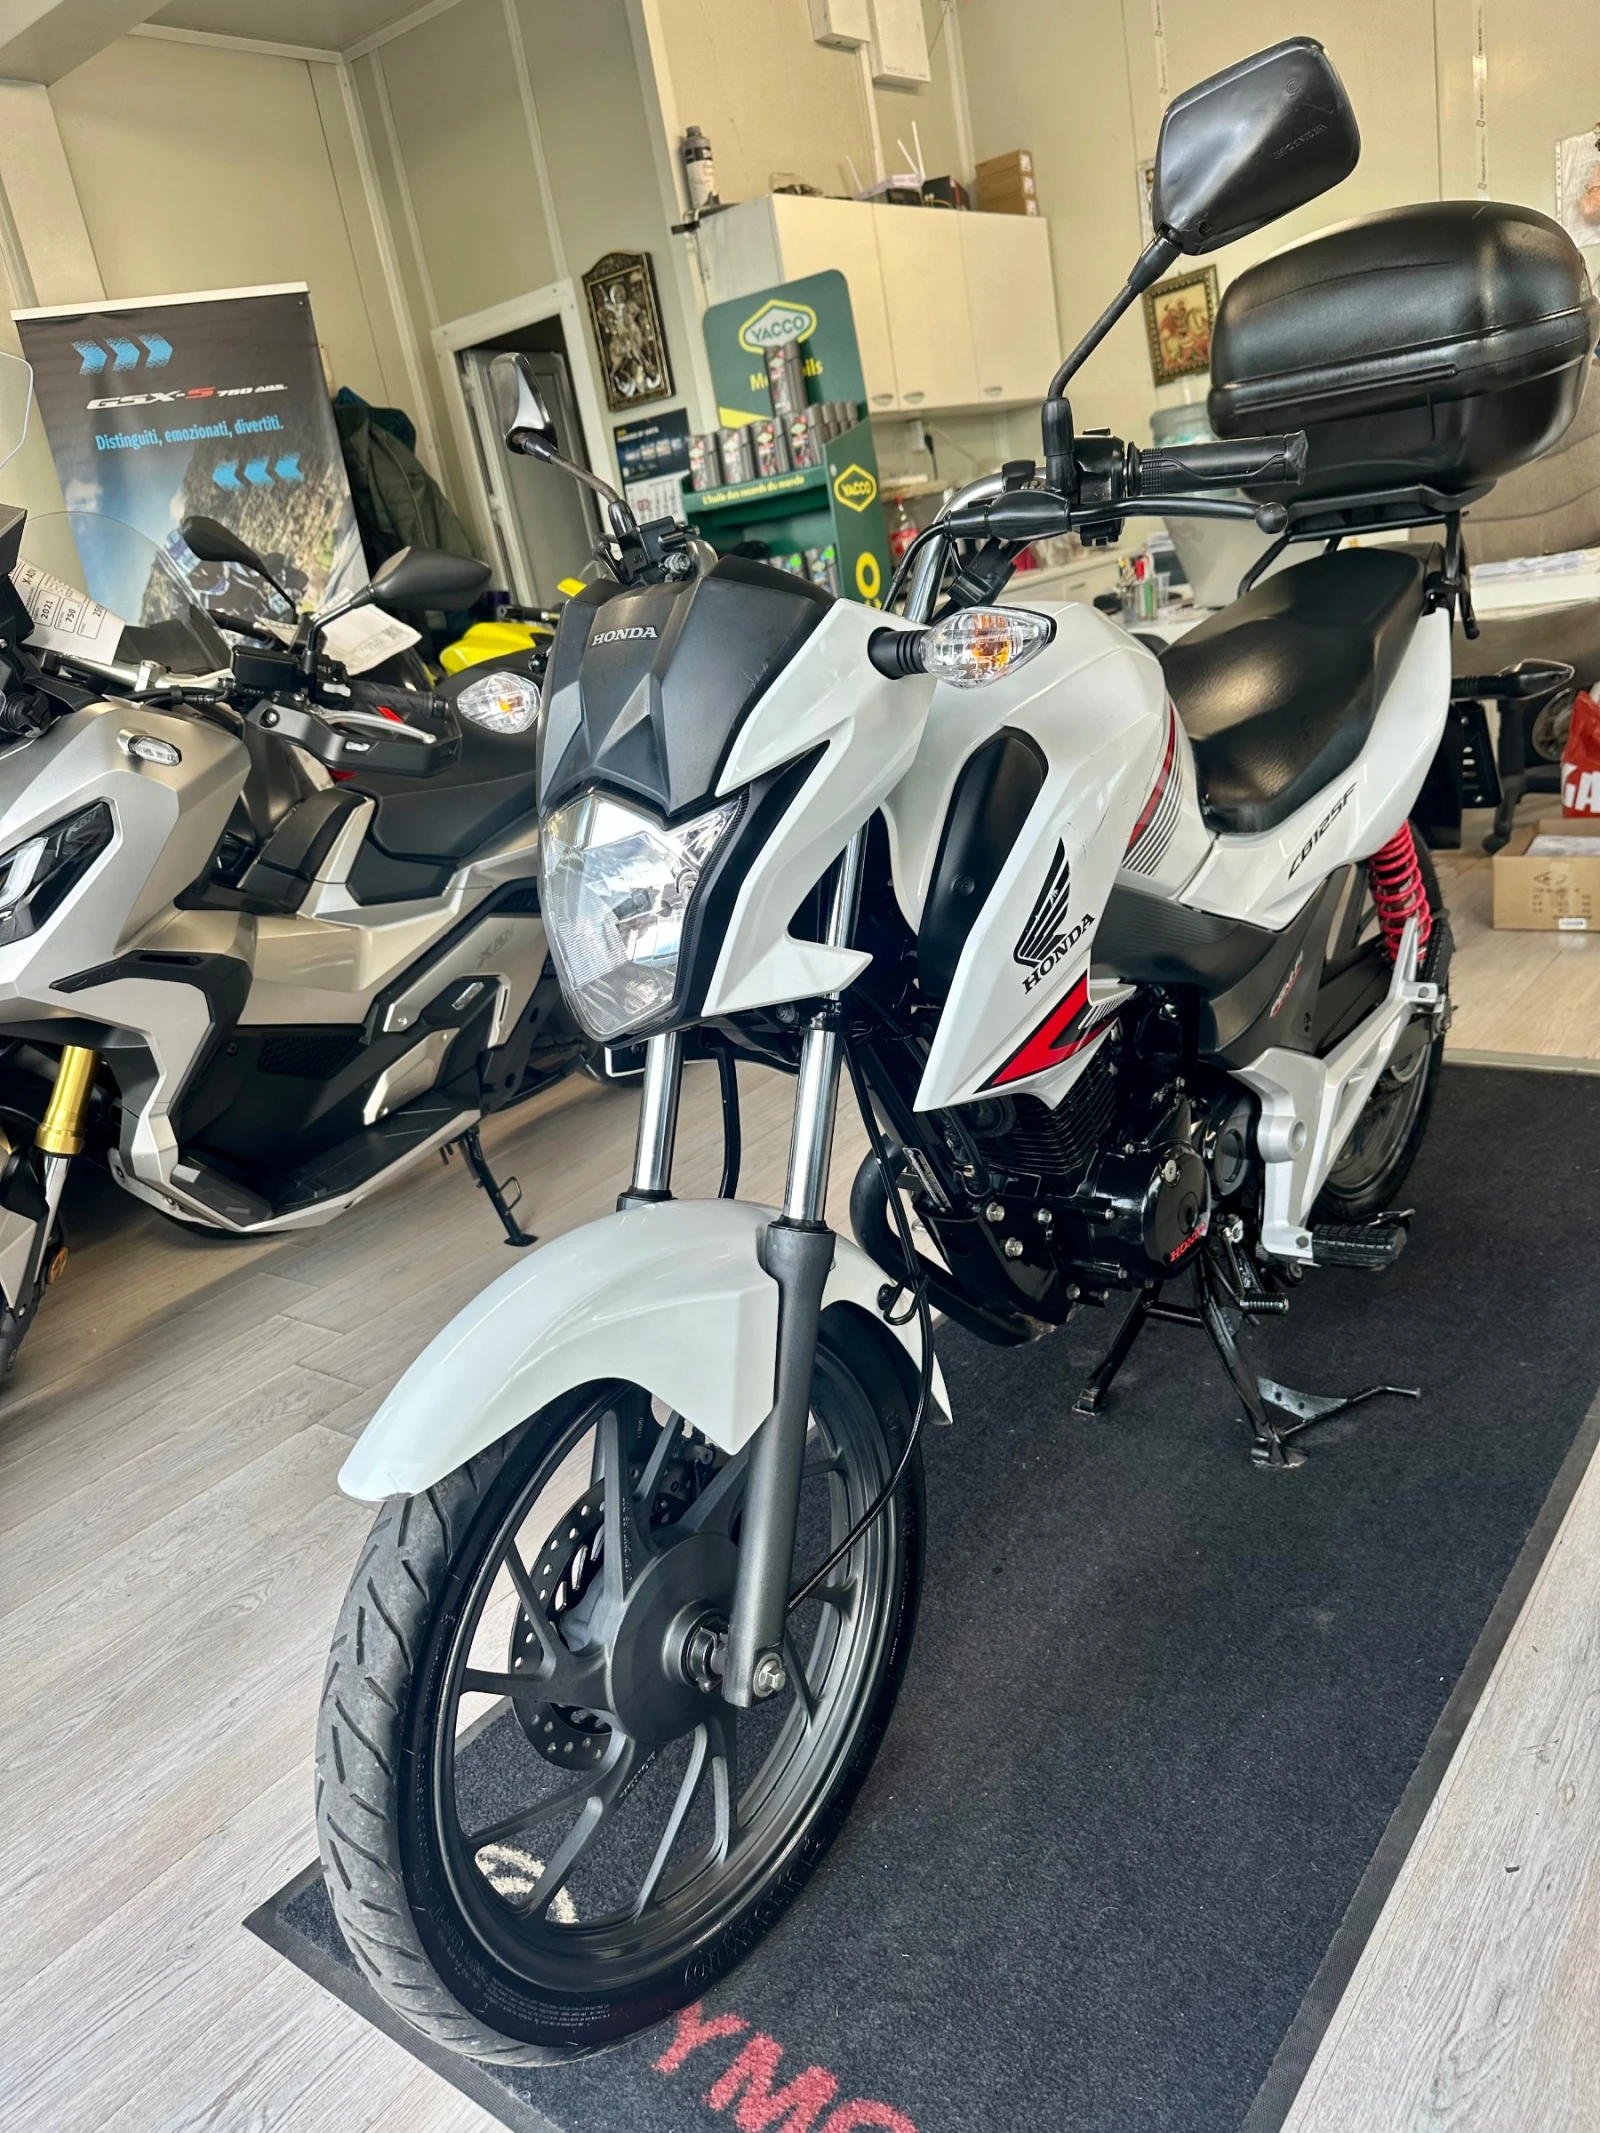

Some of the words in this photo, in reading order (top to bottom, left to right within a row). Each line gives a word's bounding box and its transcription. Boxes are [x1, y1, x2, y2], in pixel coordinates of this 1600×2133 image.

[751, 315, 805, 342] YACCO
[95, 429, 162, 451] Distinguiti,
[164, 421, 233, 444] emozionati,
[234, 415, 285, 435] divertiti.
[41, 600, 54, 619] 2021
[65, 609, 76, 623] 750
[591, 626, 658, 647] HONDA
[1288, 781, 1357, 881] CB125F
[1021, 913, 1096, 996] HONDA
[1170, 1221, 1207, 1262] HONDA
